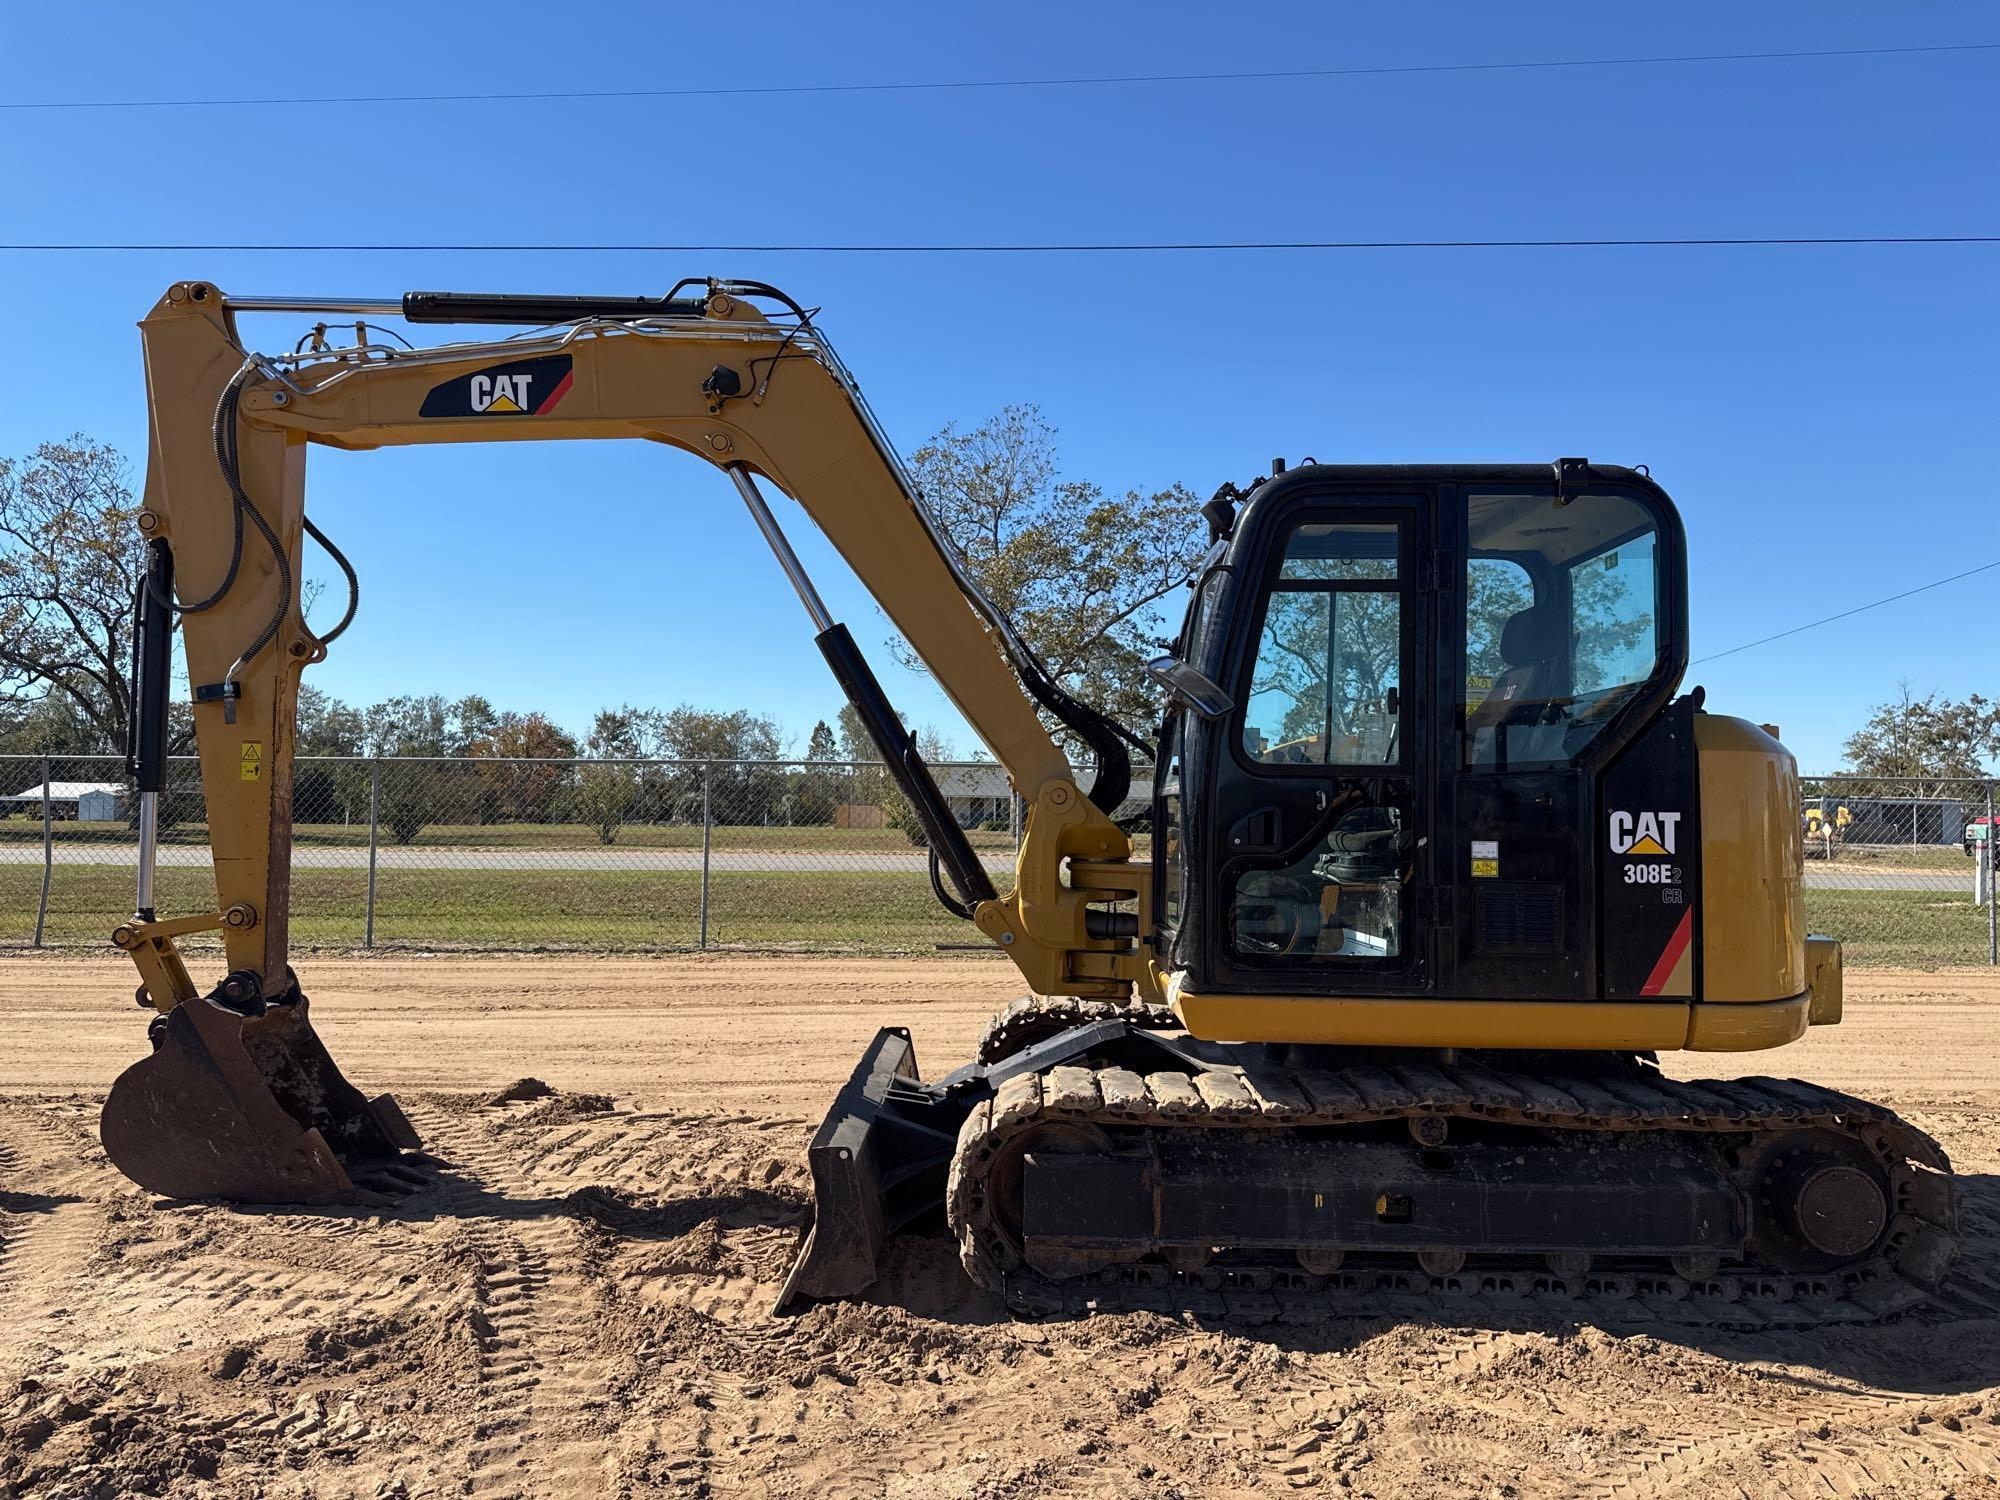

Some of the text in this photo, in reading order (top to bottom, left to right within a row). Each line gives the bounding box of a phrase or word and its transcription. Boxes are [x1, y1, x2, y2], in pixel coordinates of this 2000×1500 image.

[470, 374, 533, 412] CAT
[1609, 810, 1681, 854] CAT
[1623, 864, 1682, 884] 308E2
[1662, 888, 1683, 904] CR
